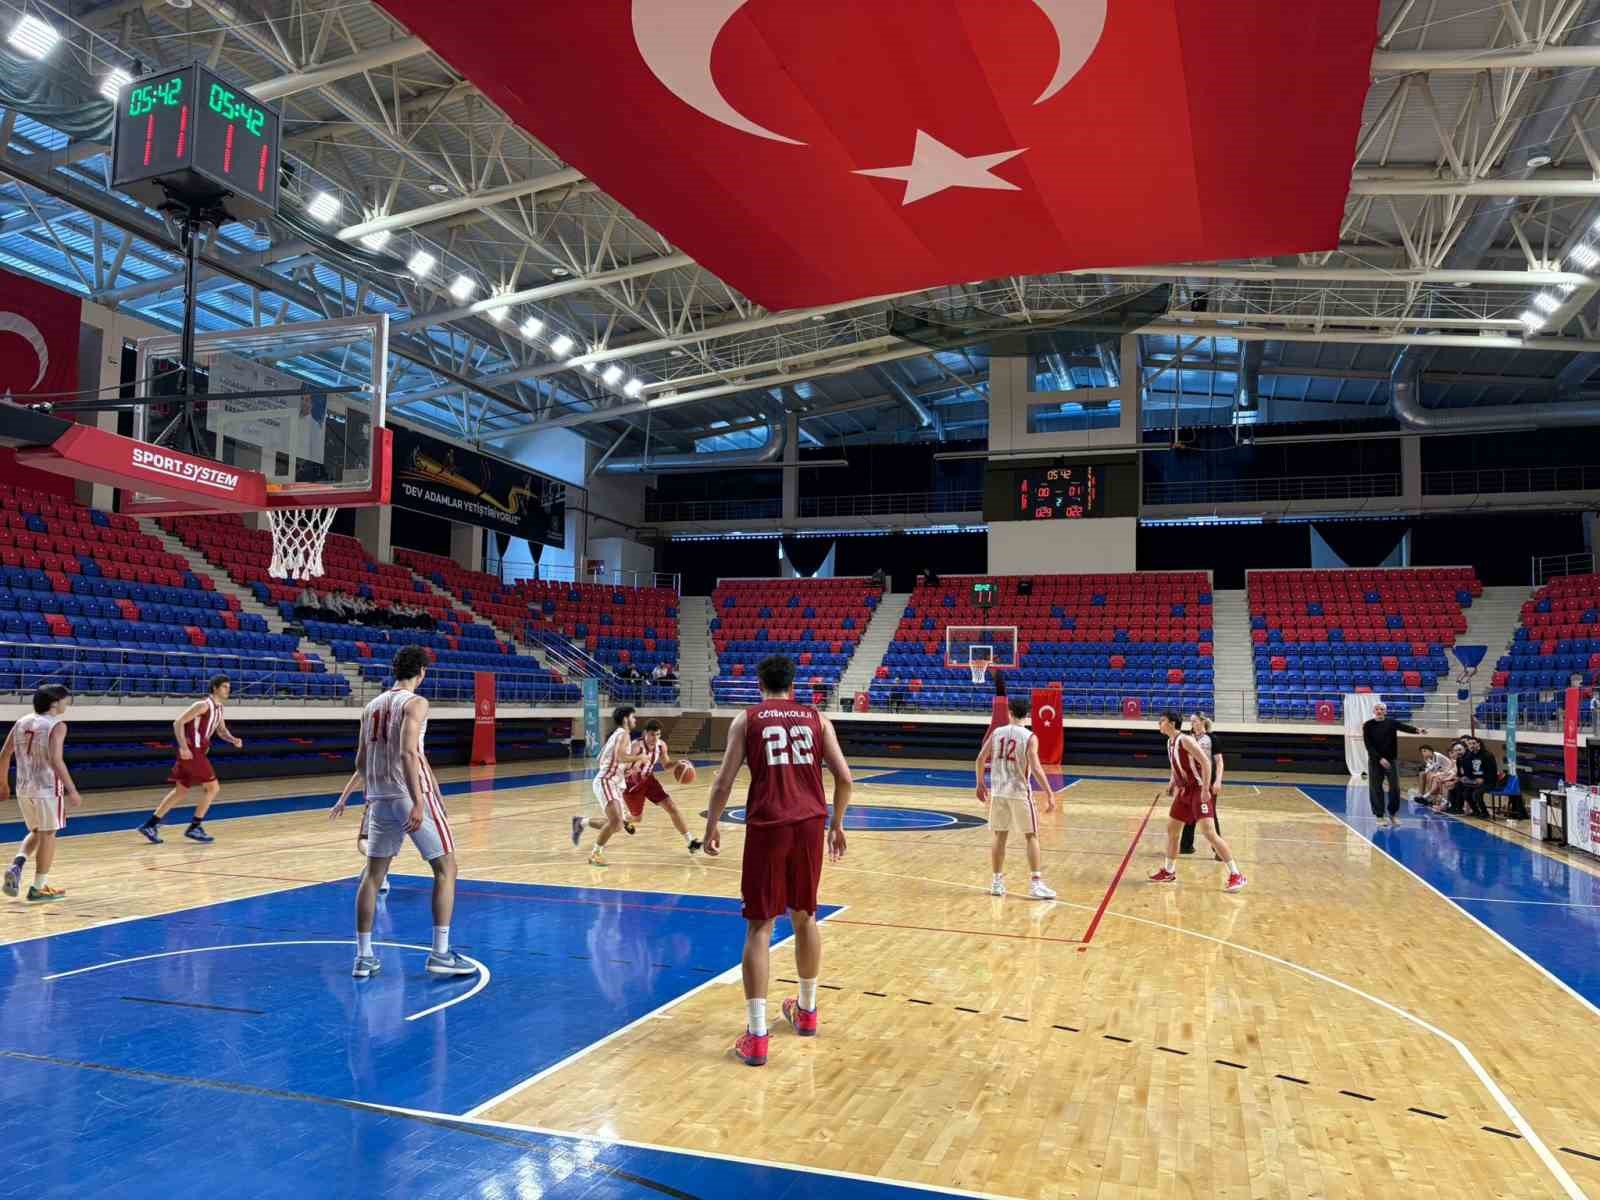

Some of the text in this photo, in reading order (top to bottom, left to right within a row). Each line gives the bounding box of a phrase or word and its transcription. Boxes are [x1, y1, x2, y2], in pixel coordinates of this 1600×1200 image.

[129, 78, 182, 116] 05:42
[209, 83, 265, 137] 05:42
[132, 448, 239, 487] SPORT SYSTEM
[424, 491, 463, 510] ADAMLAR
[25, 730, 34, 755] 7
[762, 726, 815, 765] 22
[999, 737, 1016, 761] 12
